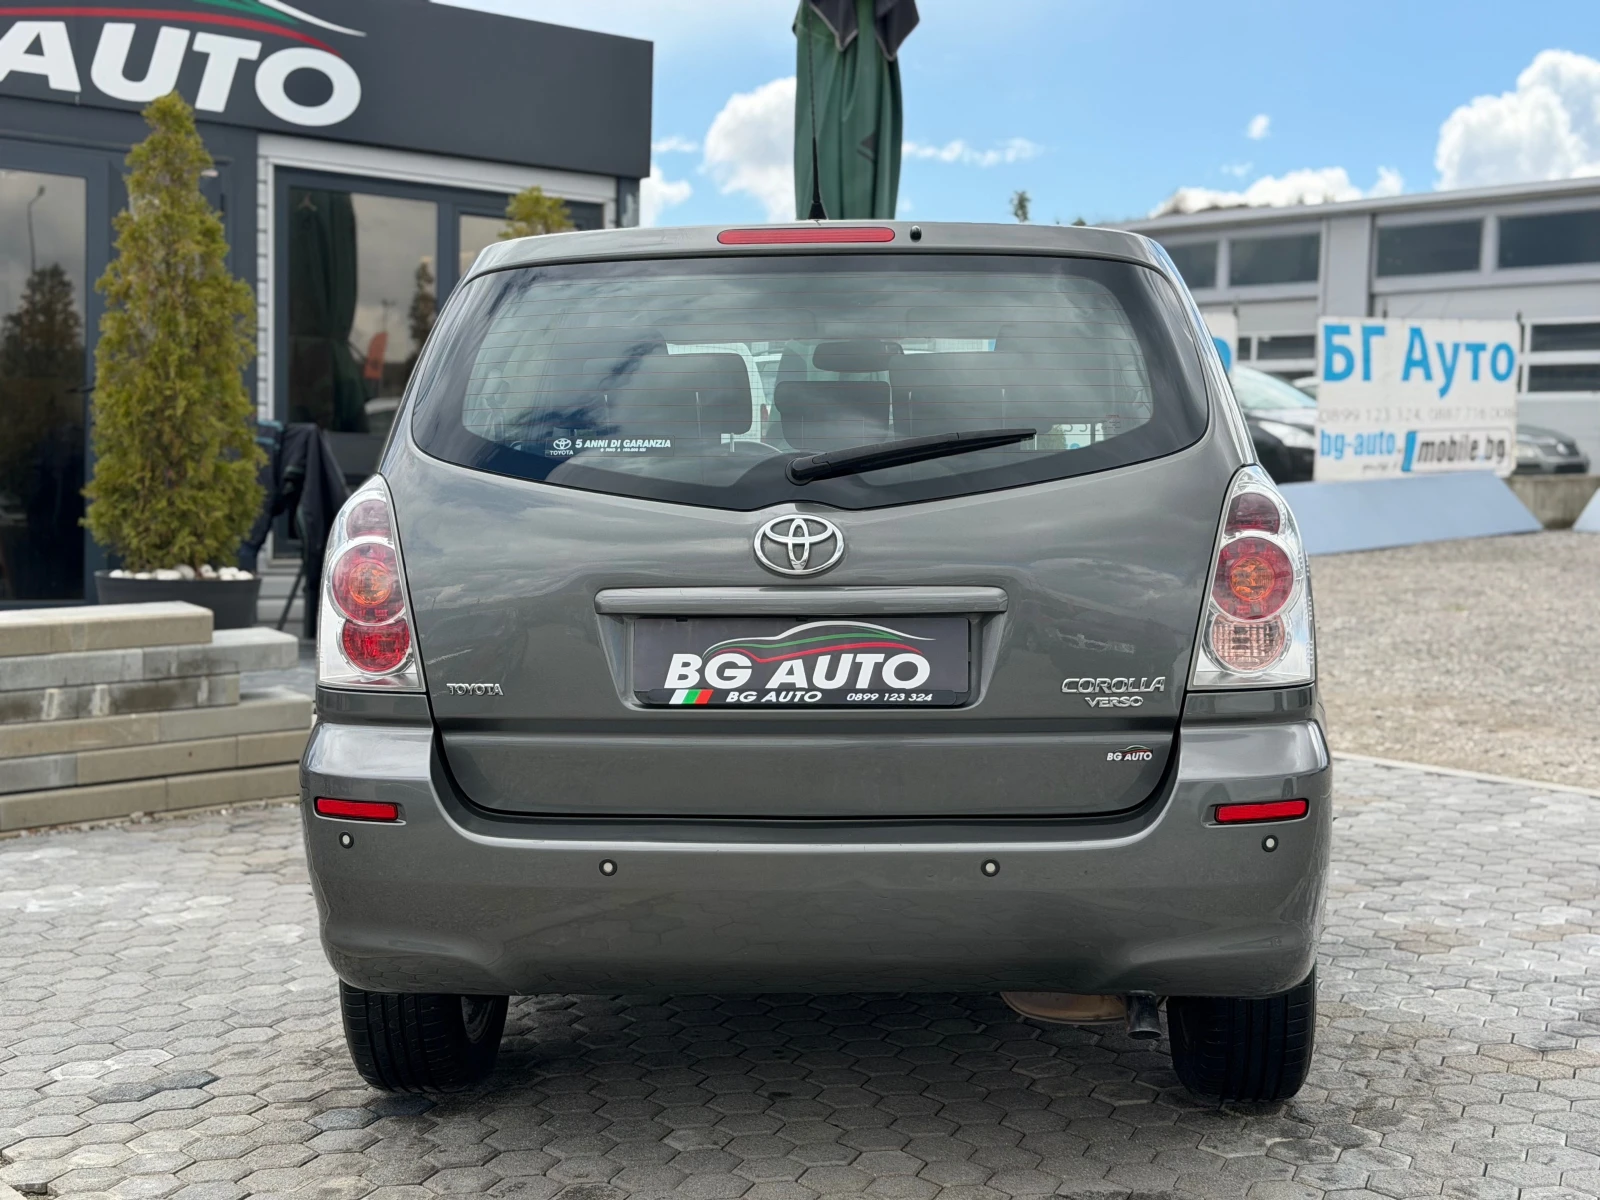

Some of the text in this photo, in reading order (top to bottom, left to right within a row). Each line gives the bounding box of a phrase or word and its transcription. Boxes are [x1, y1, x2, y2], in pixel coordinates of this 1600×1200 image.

[0, 21, 361, 126] AUTO
[1323, 324, 1515, 398] БГ Ауто
[575, 439, 671, 448] 5 ANNI DI GARANZIA
[1417, 433, 1506, 464] mobile.bg
[664, 653, 931, 690] BG AUTO
[446, 683, 504, 696] TOYOTA
[1061, 676, 1166, 694] COROLLA
[726, 691, 933, 702] BG AUTO 0899 123 324
[1085, 696, 1144, 708] VERSO
[1106, 752, 1153, 761] BG AUTO
